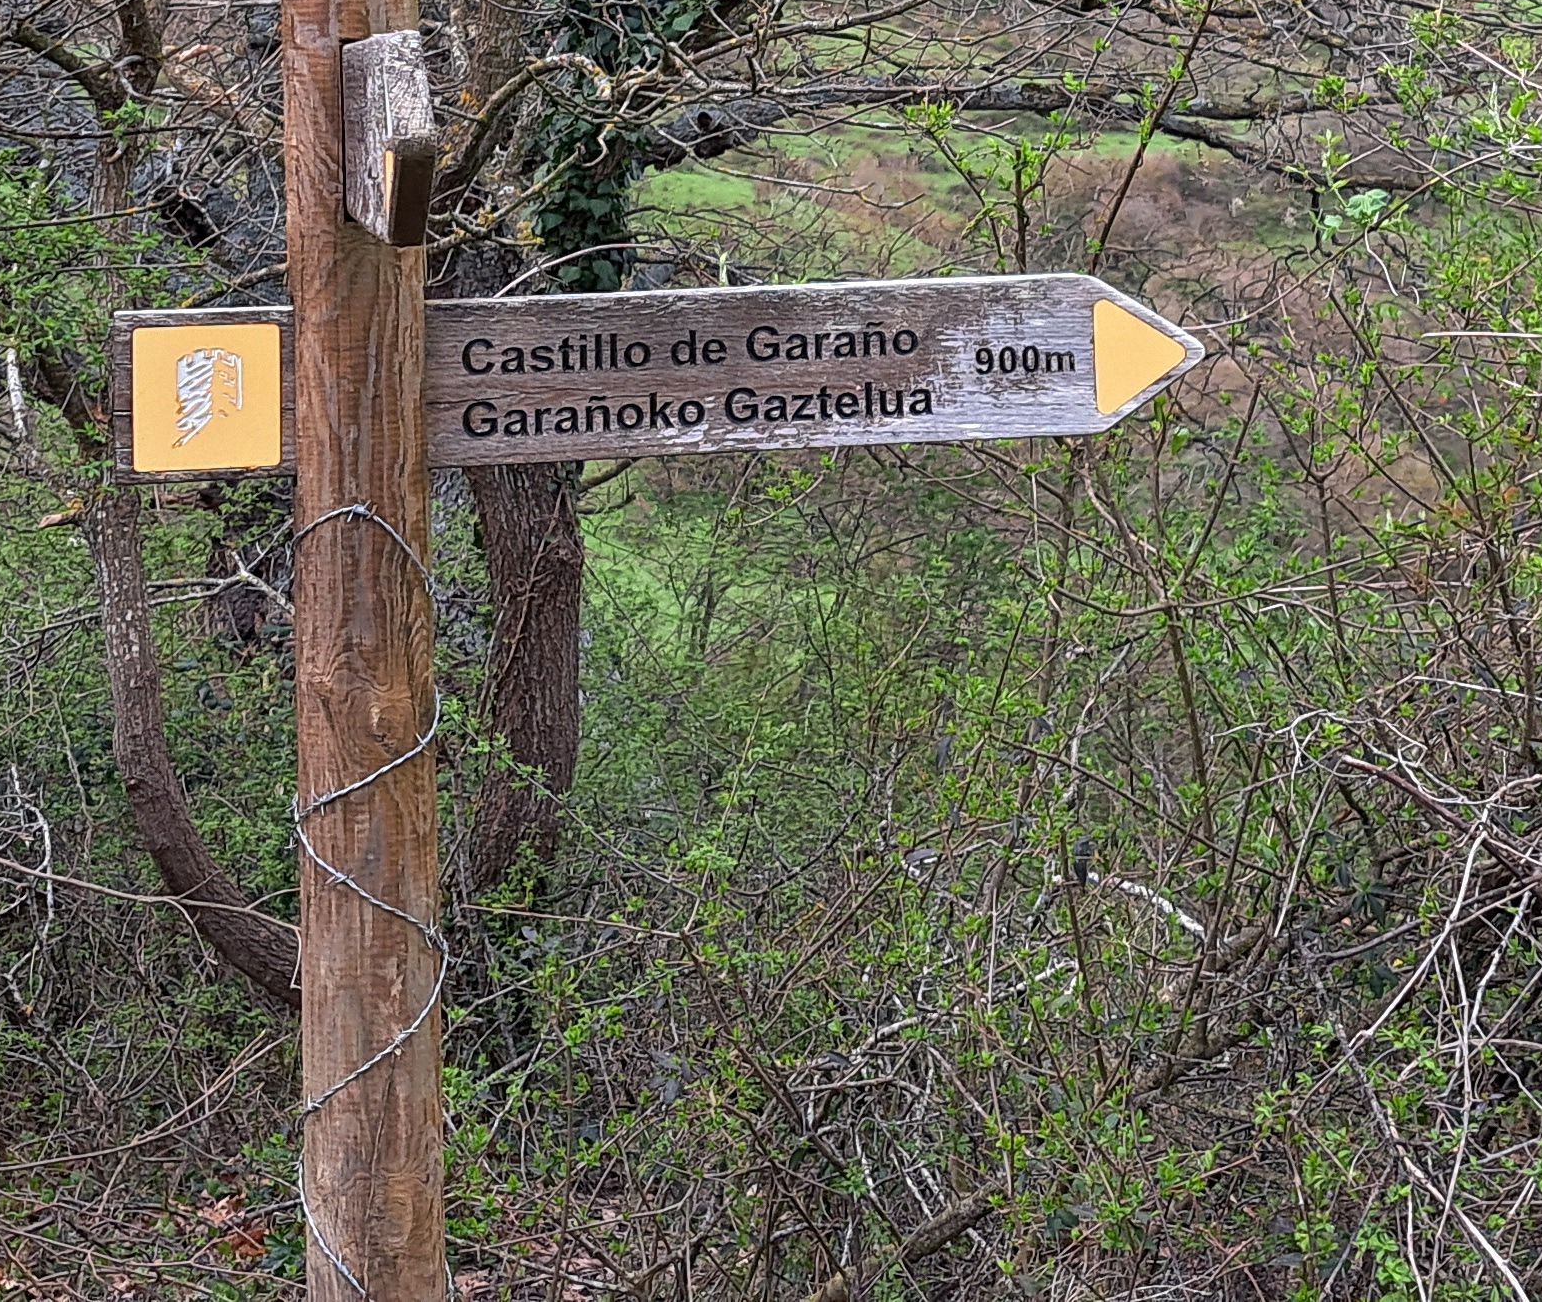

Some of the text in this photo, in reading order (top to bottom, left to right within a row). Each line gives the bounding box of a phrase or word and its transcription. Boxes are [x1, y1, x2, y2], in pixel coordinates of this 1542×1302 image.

[461, 320, 920, 377] Castillo de Garaño
[974, 344, 1076, 376] 900m
[462, 380, 934, 439] Garañoko Gaztelua
